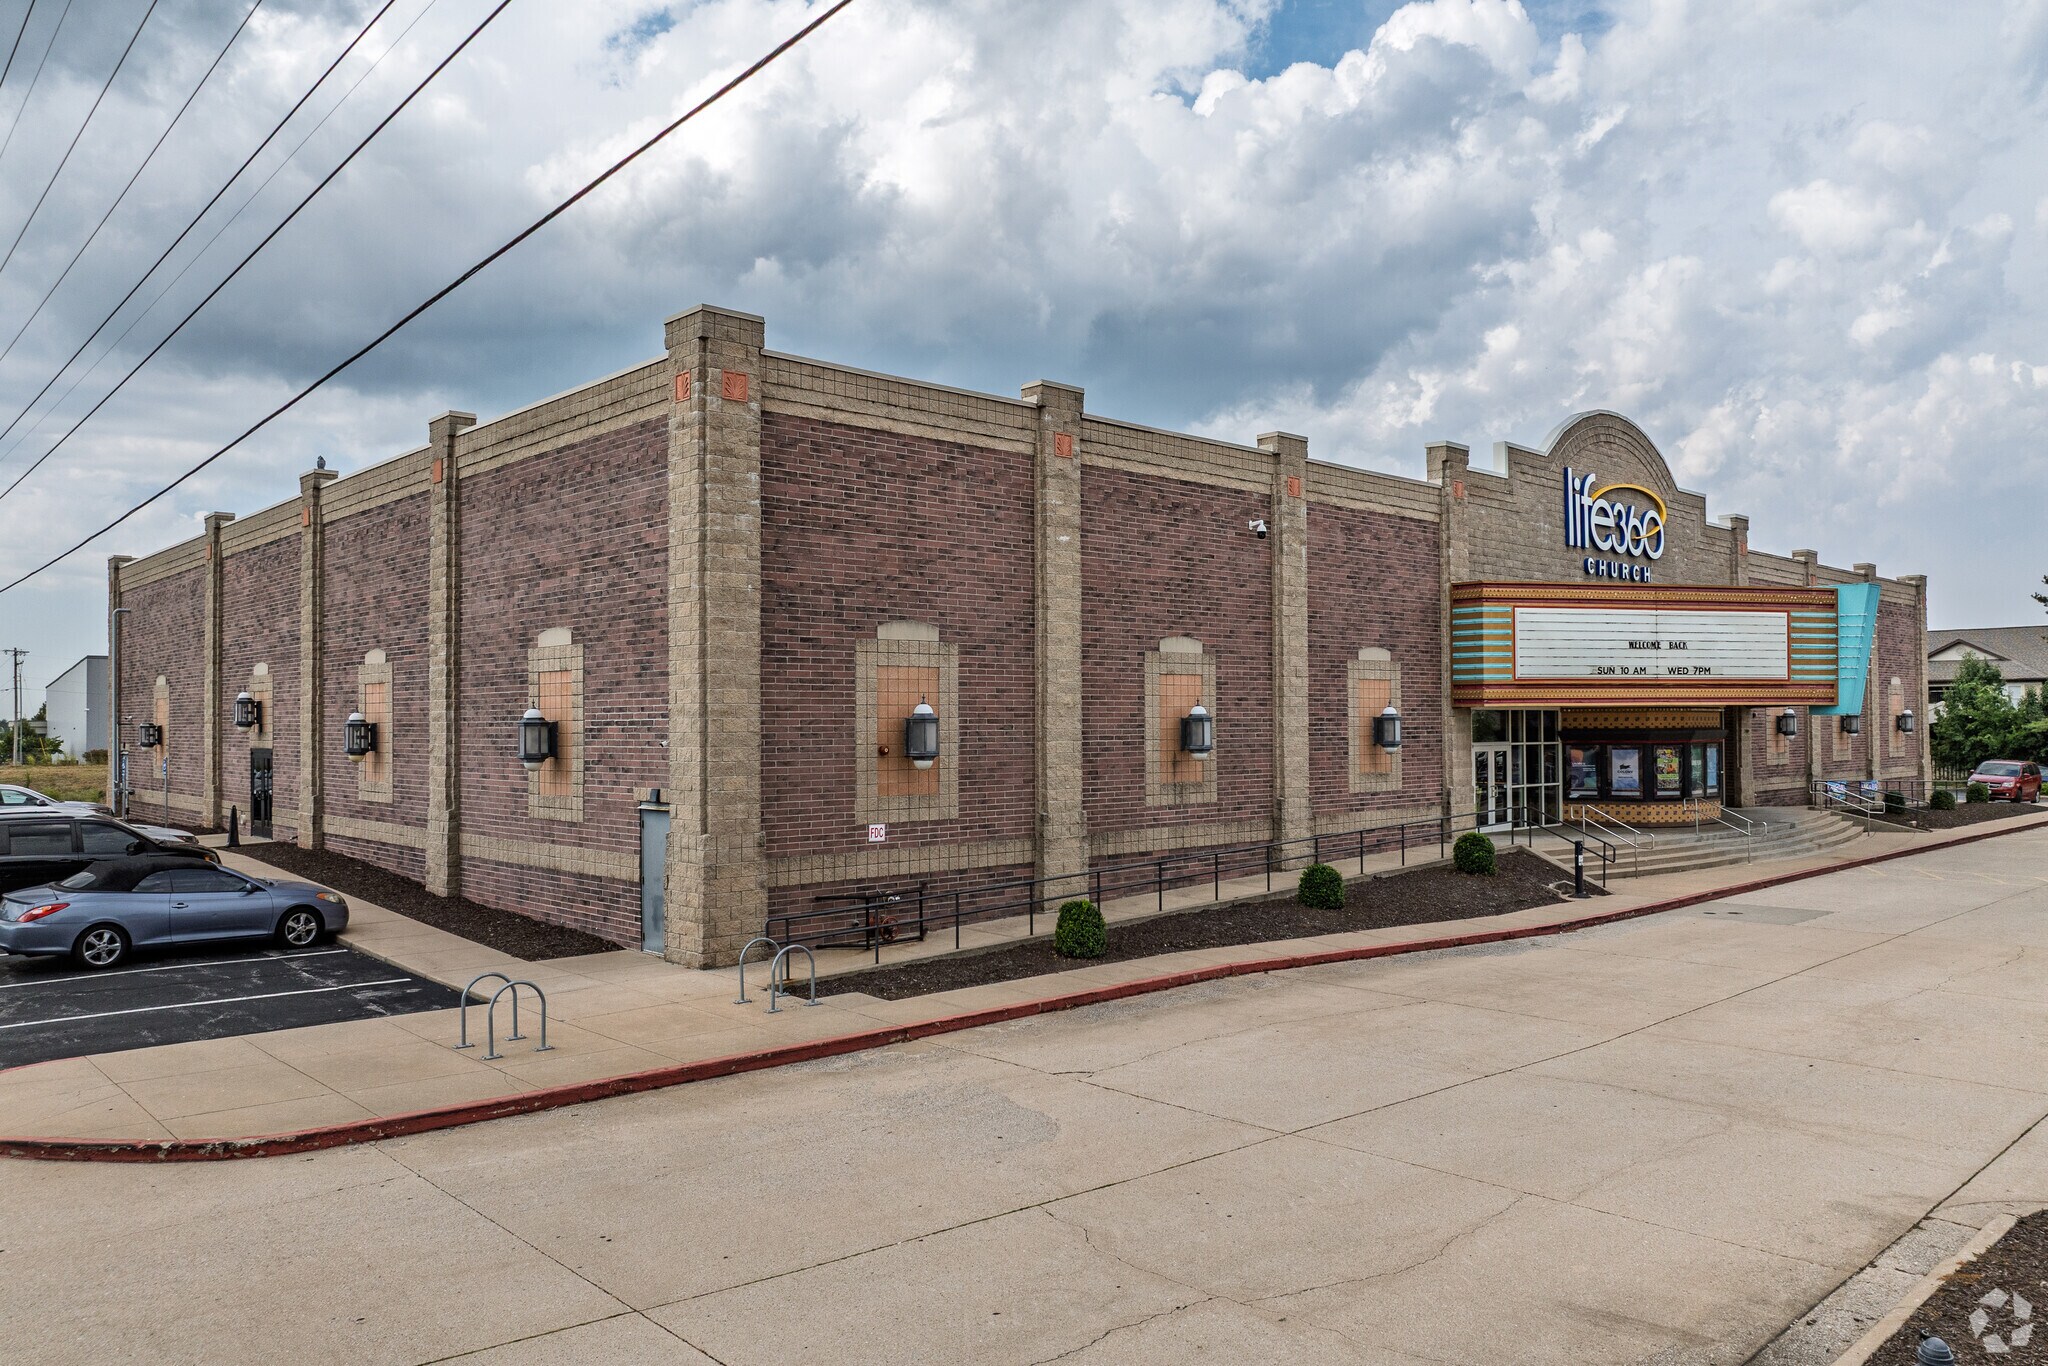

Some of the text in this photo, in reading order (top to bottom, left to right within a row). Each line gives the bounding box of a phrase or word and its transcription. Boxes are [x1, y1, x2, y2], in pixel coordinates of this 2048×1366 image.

[1564, 467, 1665, 560] life360
[1584, 557, 1652, 583] CHURCH
[1628, 641, 1688, 650] WELCOME BACK
[1597, 666, 1711, 675] SUN 10 AM WED 7PM
[870, 827, 884, 838] FDC
